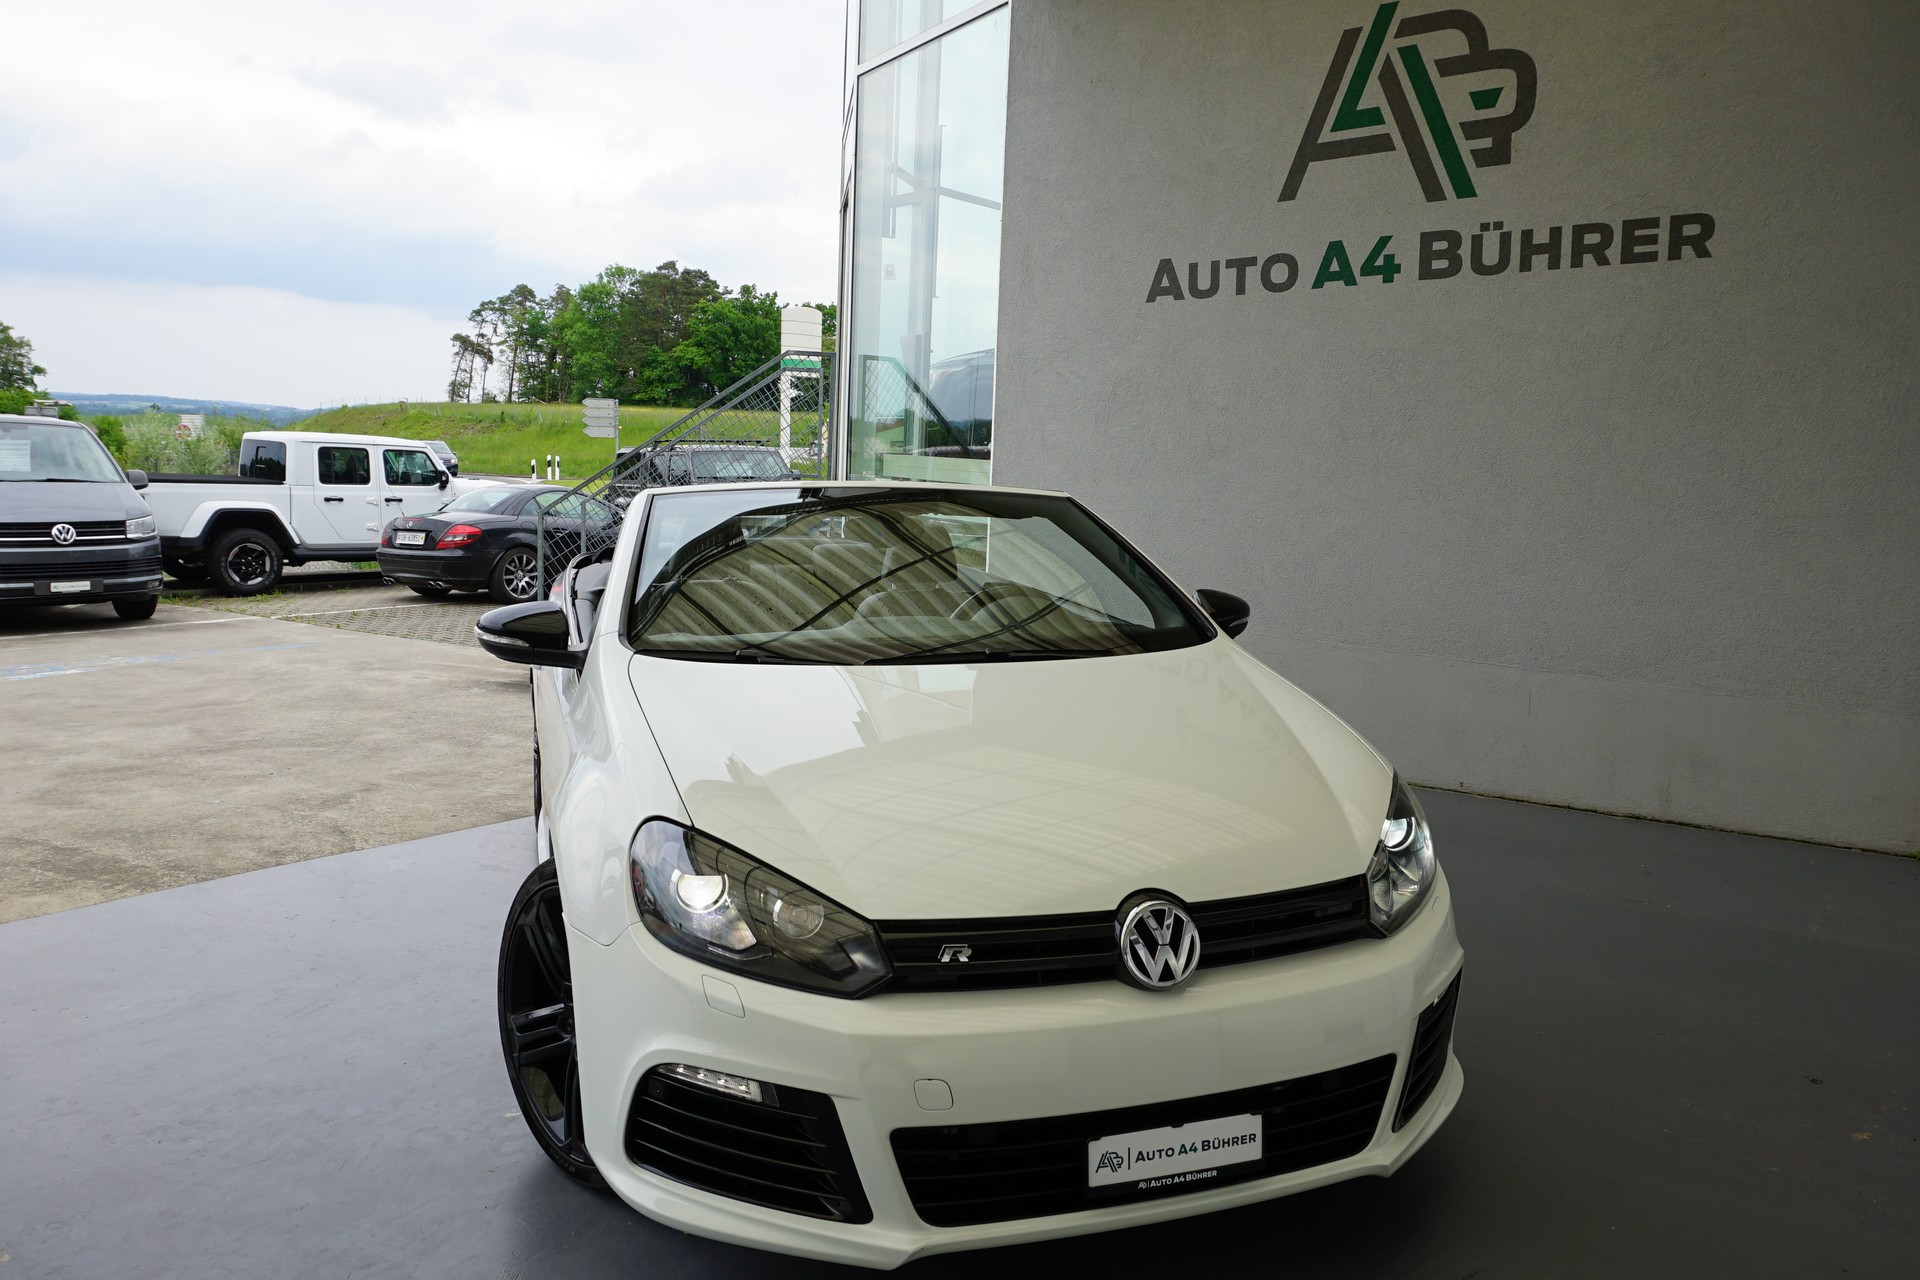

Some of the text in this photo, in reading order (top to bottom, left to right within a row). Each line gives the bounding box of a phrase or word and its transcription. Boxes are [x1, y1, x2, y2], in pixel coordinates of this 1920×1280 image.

[1145, 212, 1716, 303] AUTO A4 BÜHRER
[938, 944, 972, 963] R
[1122, 902, 1200, 987] VW
[1135, 1147, 1175, 1163] AUTO
[1178, 1142, 1199, 1156] A4
[1201, 1133, 1257, 1152] BÜHRER
[1150, 1178, 1172, 1187] AUTO
[1173, 1175, 1185, 1184] A4
[1186, 1170, 1218, 1182] BÜHRER
